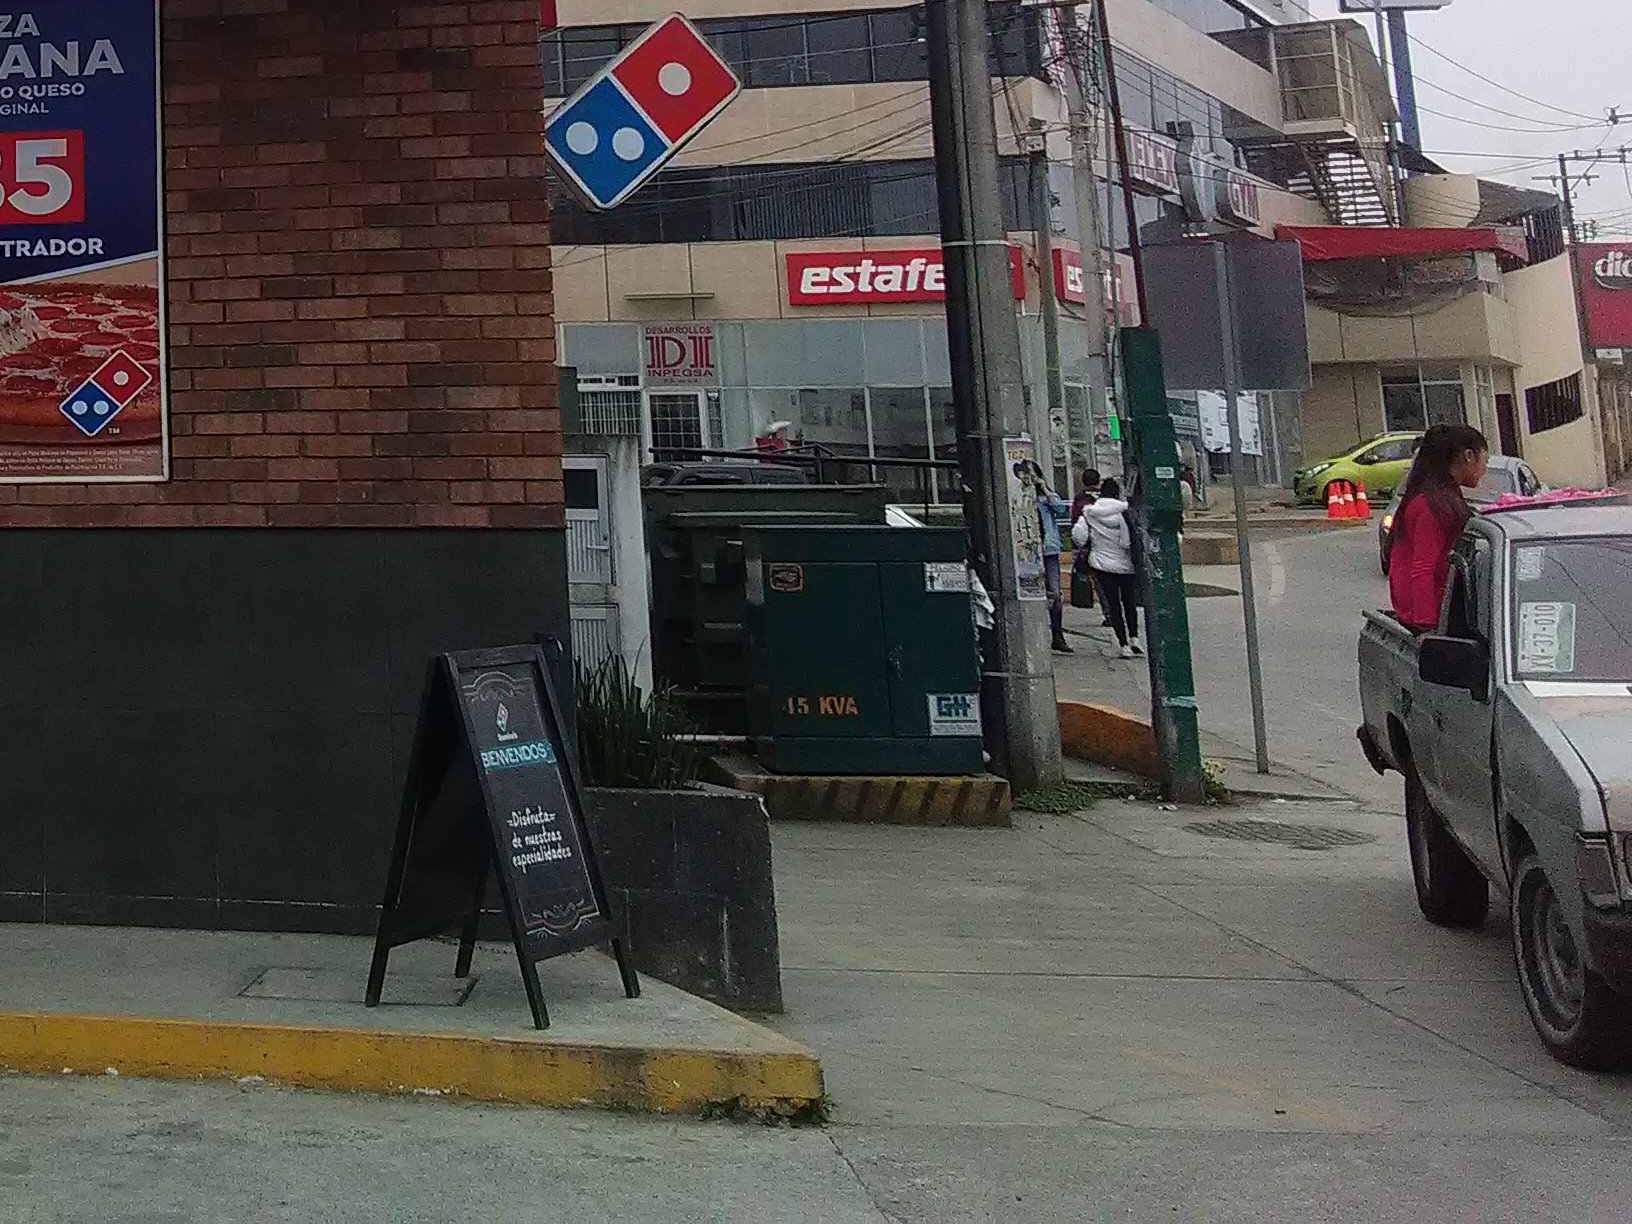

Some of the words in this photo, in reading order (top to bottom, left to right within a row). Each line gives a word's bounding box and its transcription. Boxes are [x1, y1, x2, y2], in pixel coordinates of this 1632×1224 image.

[0, 86, 14, 100] O
[18, 82, 86, 100] QUESO
[800, 258, 946, 295] estafe
[645, 326, 712, 335] DESARROLLOS
[648, 368, 713, 377] INPEGSA
[819, 696, 859, 716] KVA
[481, 742, 547, 768] BIENVENIDOS
[512, 832, 523, 848] de
[525, 825, 562, 846] nuestras
[512, 843, 572, 874] especialidades
